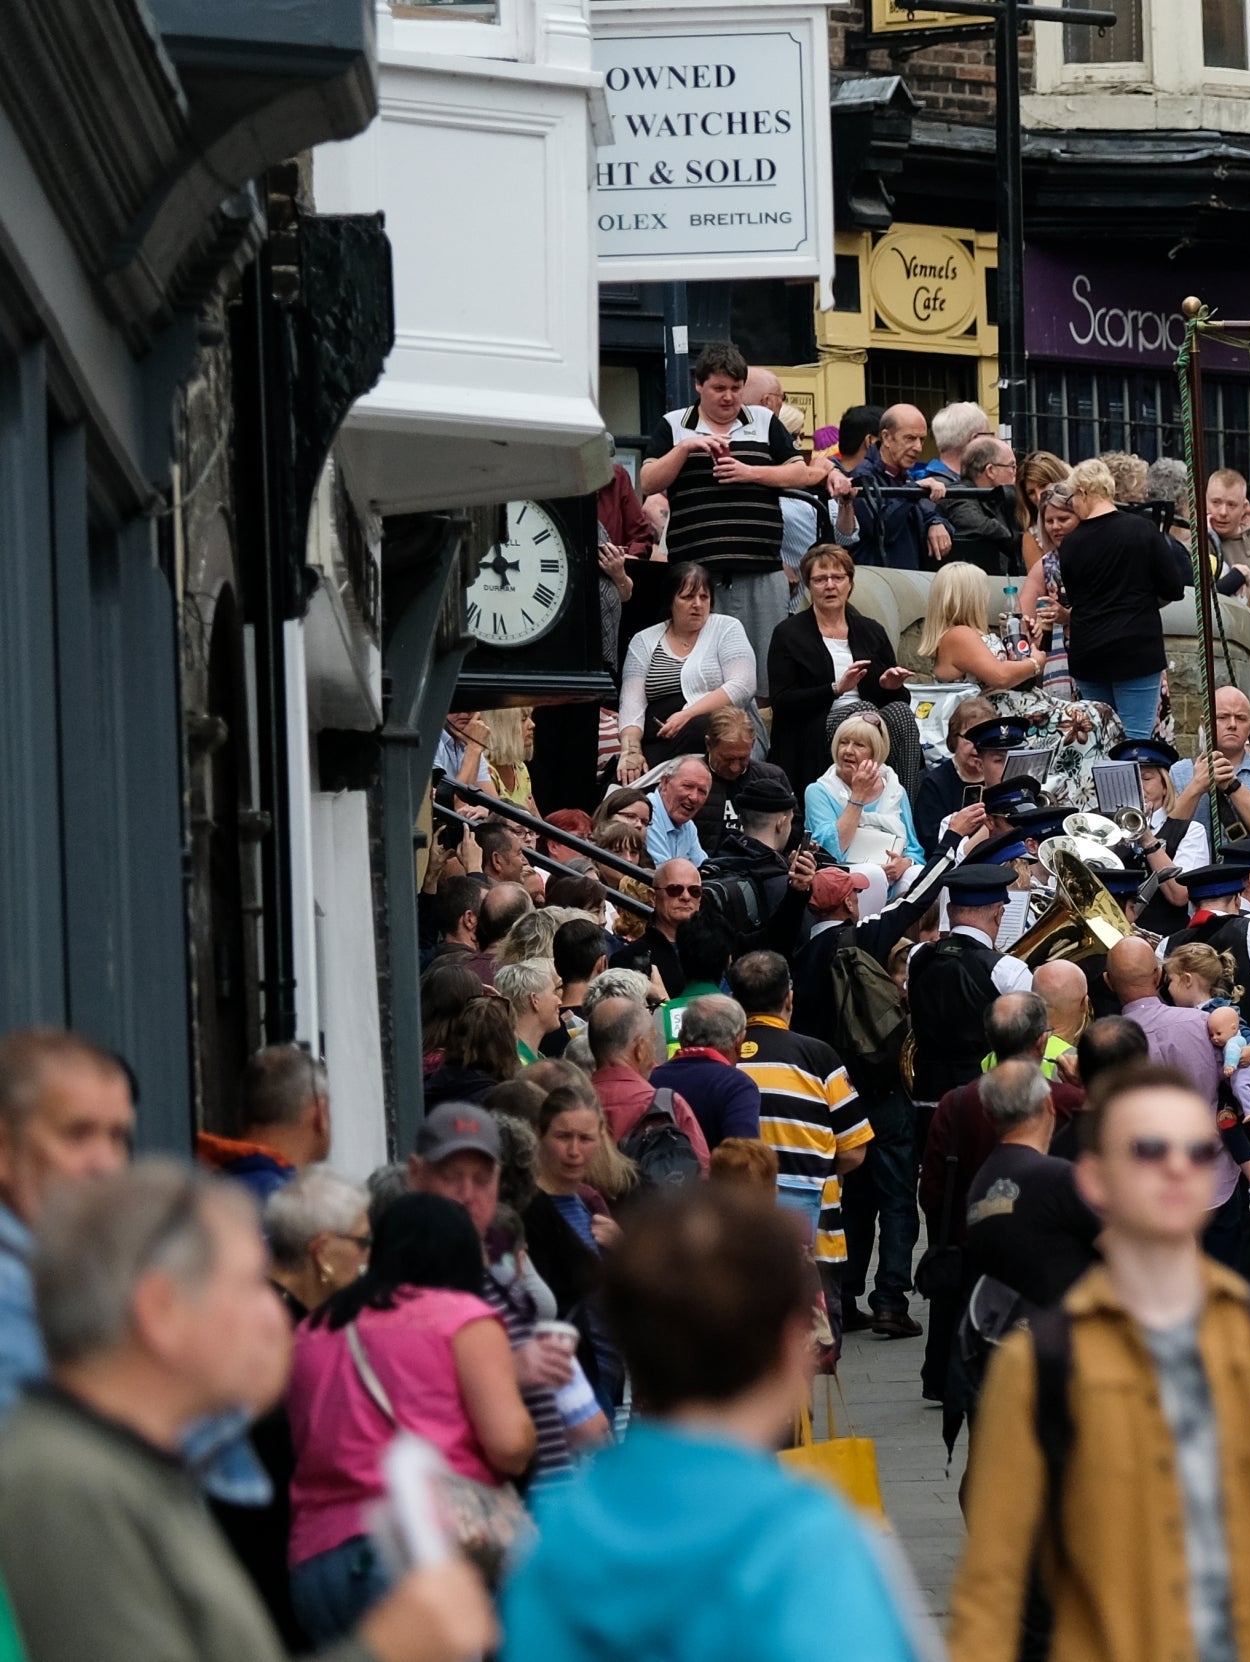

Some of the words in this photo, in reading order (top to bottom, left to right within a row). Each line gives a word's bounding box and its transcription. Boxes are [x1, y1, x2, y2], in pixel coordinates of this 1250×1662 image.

[606, 64, 736, 91] OWNED
[625, 110, 792, 138] WATCHES
[649, 160, 675, 185] &
[686, 157, 777, 184] SOLD
[690, 211, 792, 226] BREITLING
[891, 247, 957, 280] Vennels
[913, 286, 946, 321] Cafe
